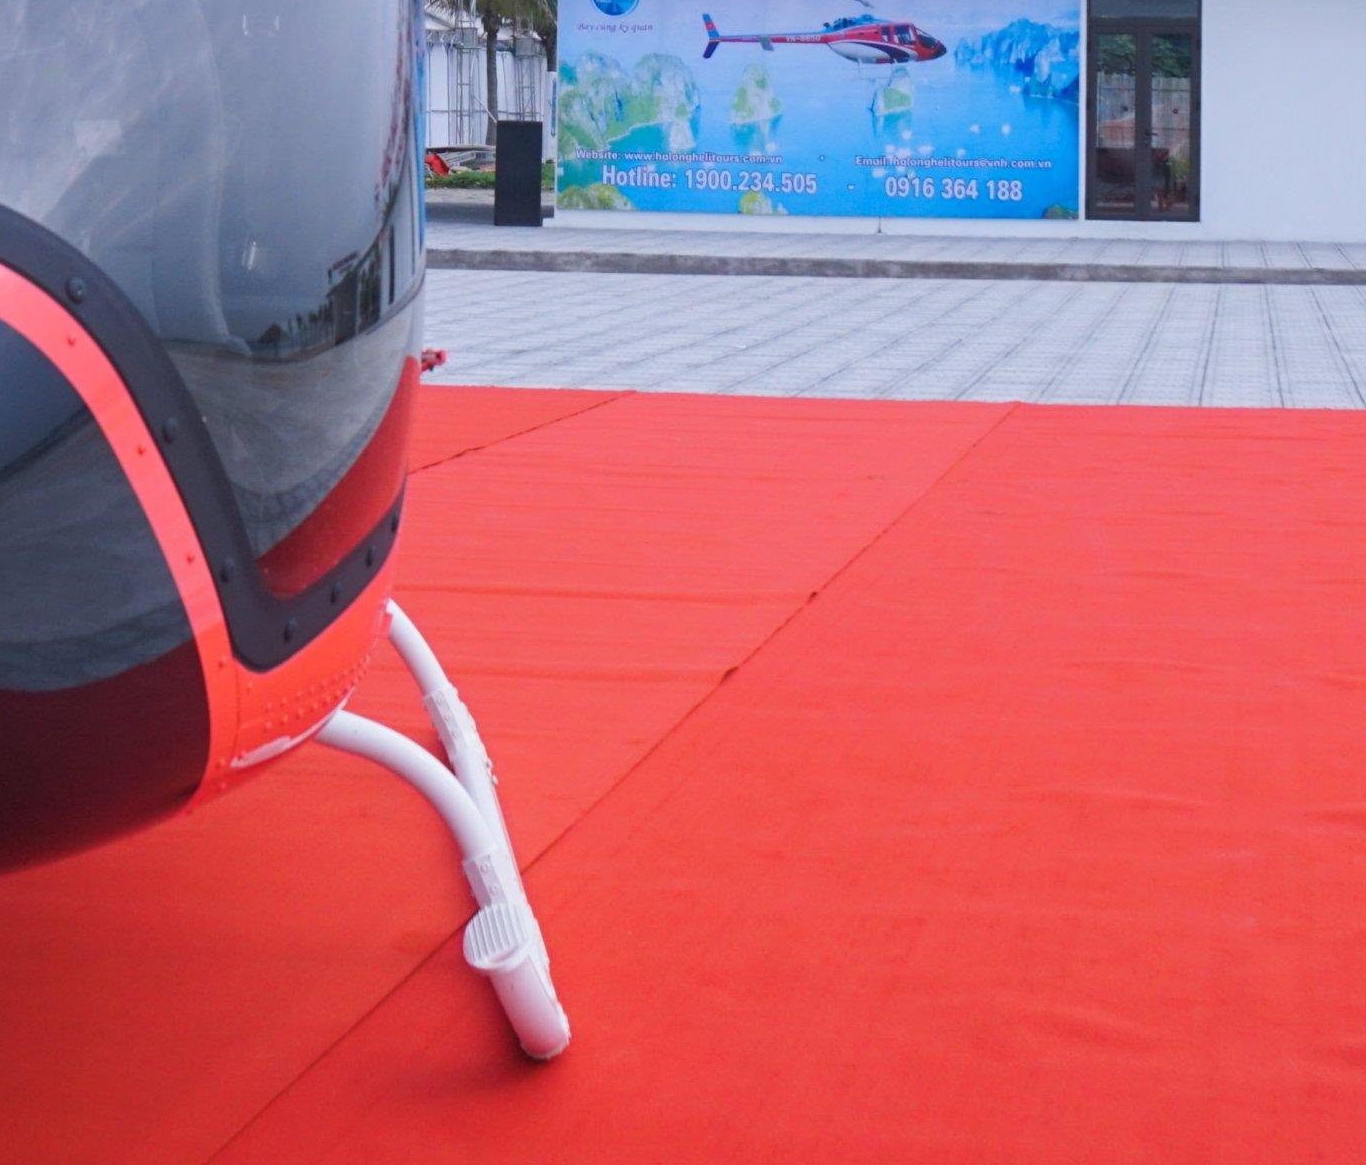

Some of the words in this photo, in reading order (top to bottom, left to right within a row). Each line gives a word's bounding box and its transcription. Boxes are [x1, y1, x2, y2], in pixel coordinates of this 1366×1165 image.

[575, 149, 621, 161] Website:
[624, 150, 782, 165] www.halonghelitours.com.vn
[602, 164, 677, 188] Hotline:
[684, 168, 818, 195] 1900.234.505
[885, 175, 935, 199] 0916
[941, 177, 979, 200] 364
[986, 179, 1023, 201] 188
